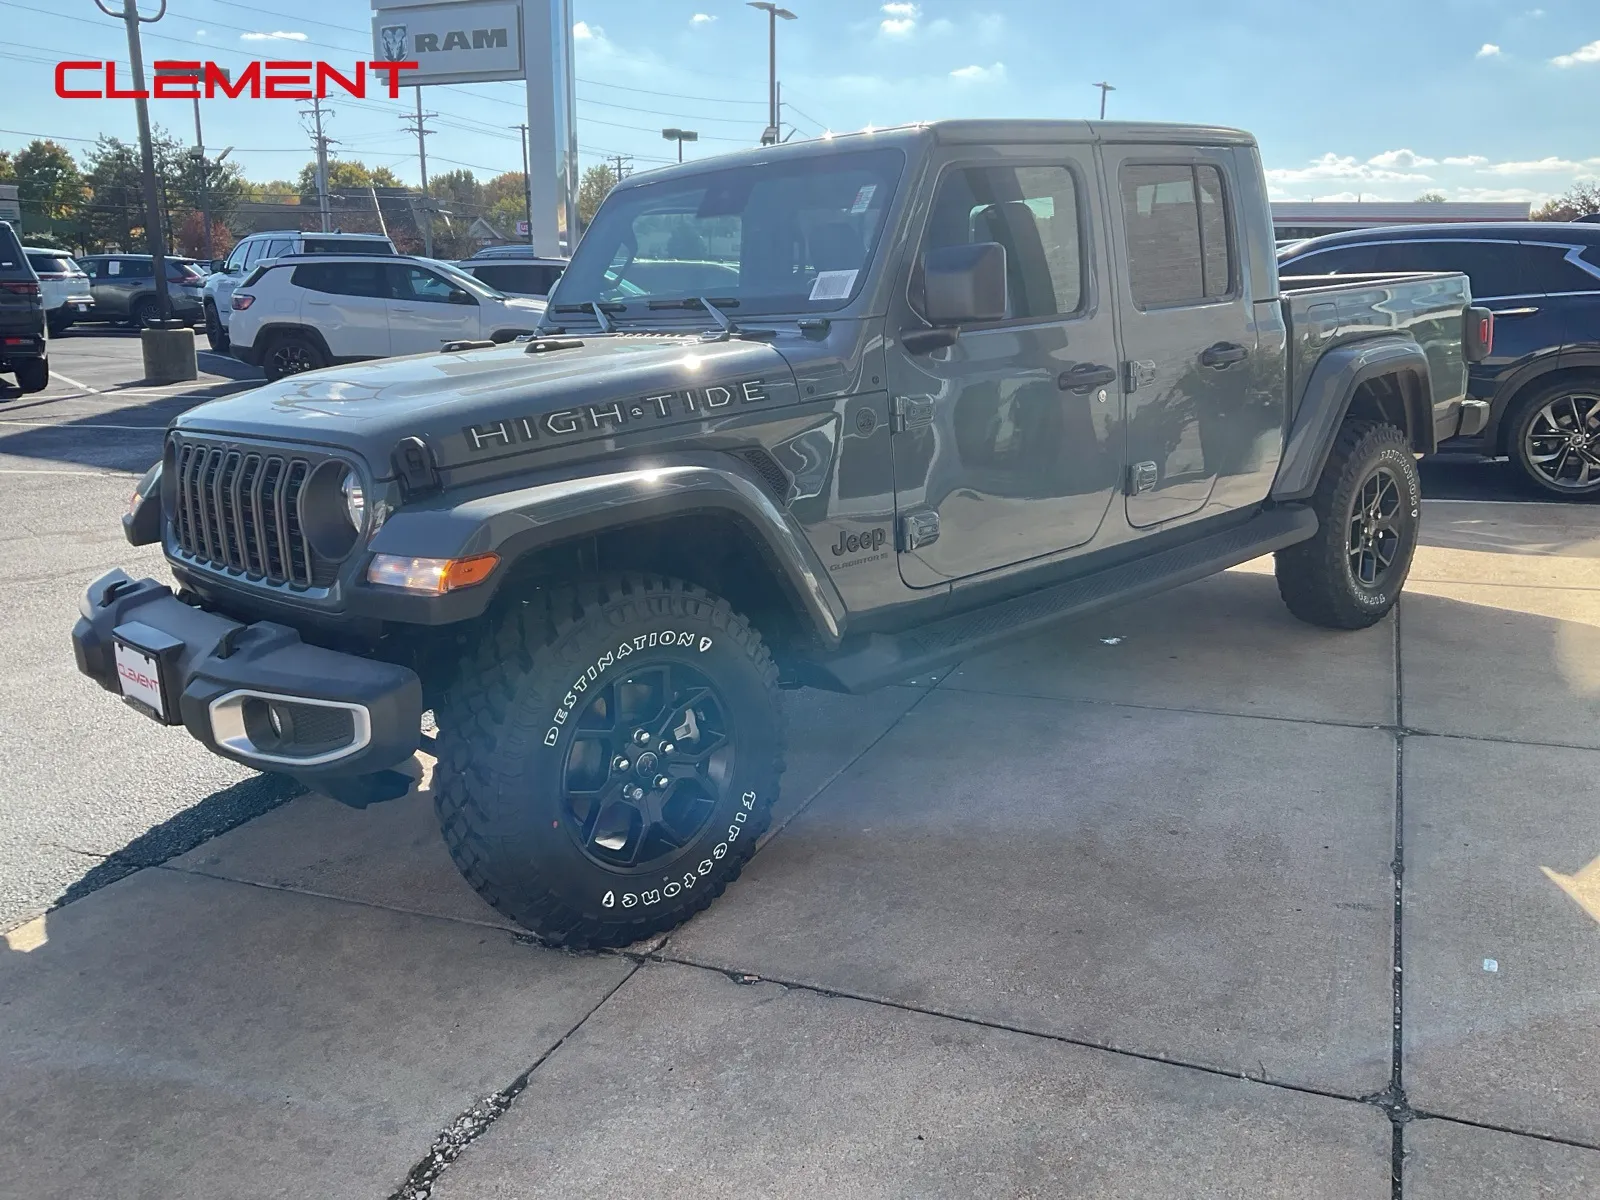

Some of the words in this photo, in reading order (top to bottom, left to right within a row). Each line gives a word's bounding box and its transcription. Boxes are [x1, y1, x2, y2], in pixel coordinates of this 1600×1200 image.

[414, 28, 508, 53] RAM
[462, 400, 628, 450] HIGH
[647, 378, 770, 419] TIDE
[832, 528, 886, 556] Jeep
[830, 554, 880, 571] GLADIATOR
[117, 663, 158, 693] CLEMENT
[544, 630, 695, 747] DESTINATION
[621, 791, 757, 908] Firestone
